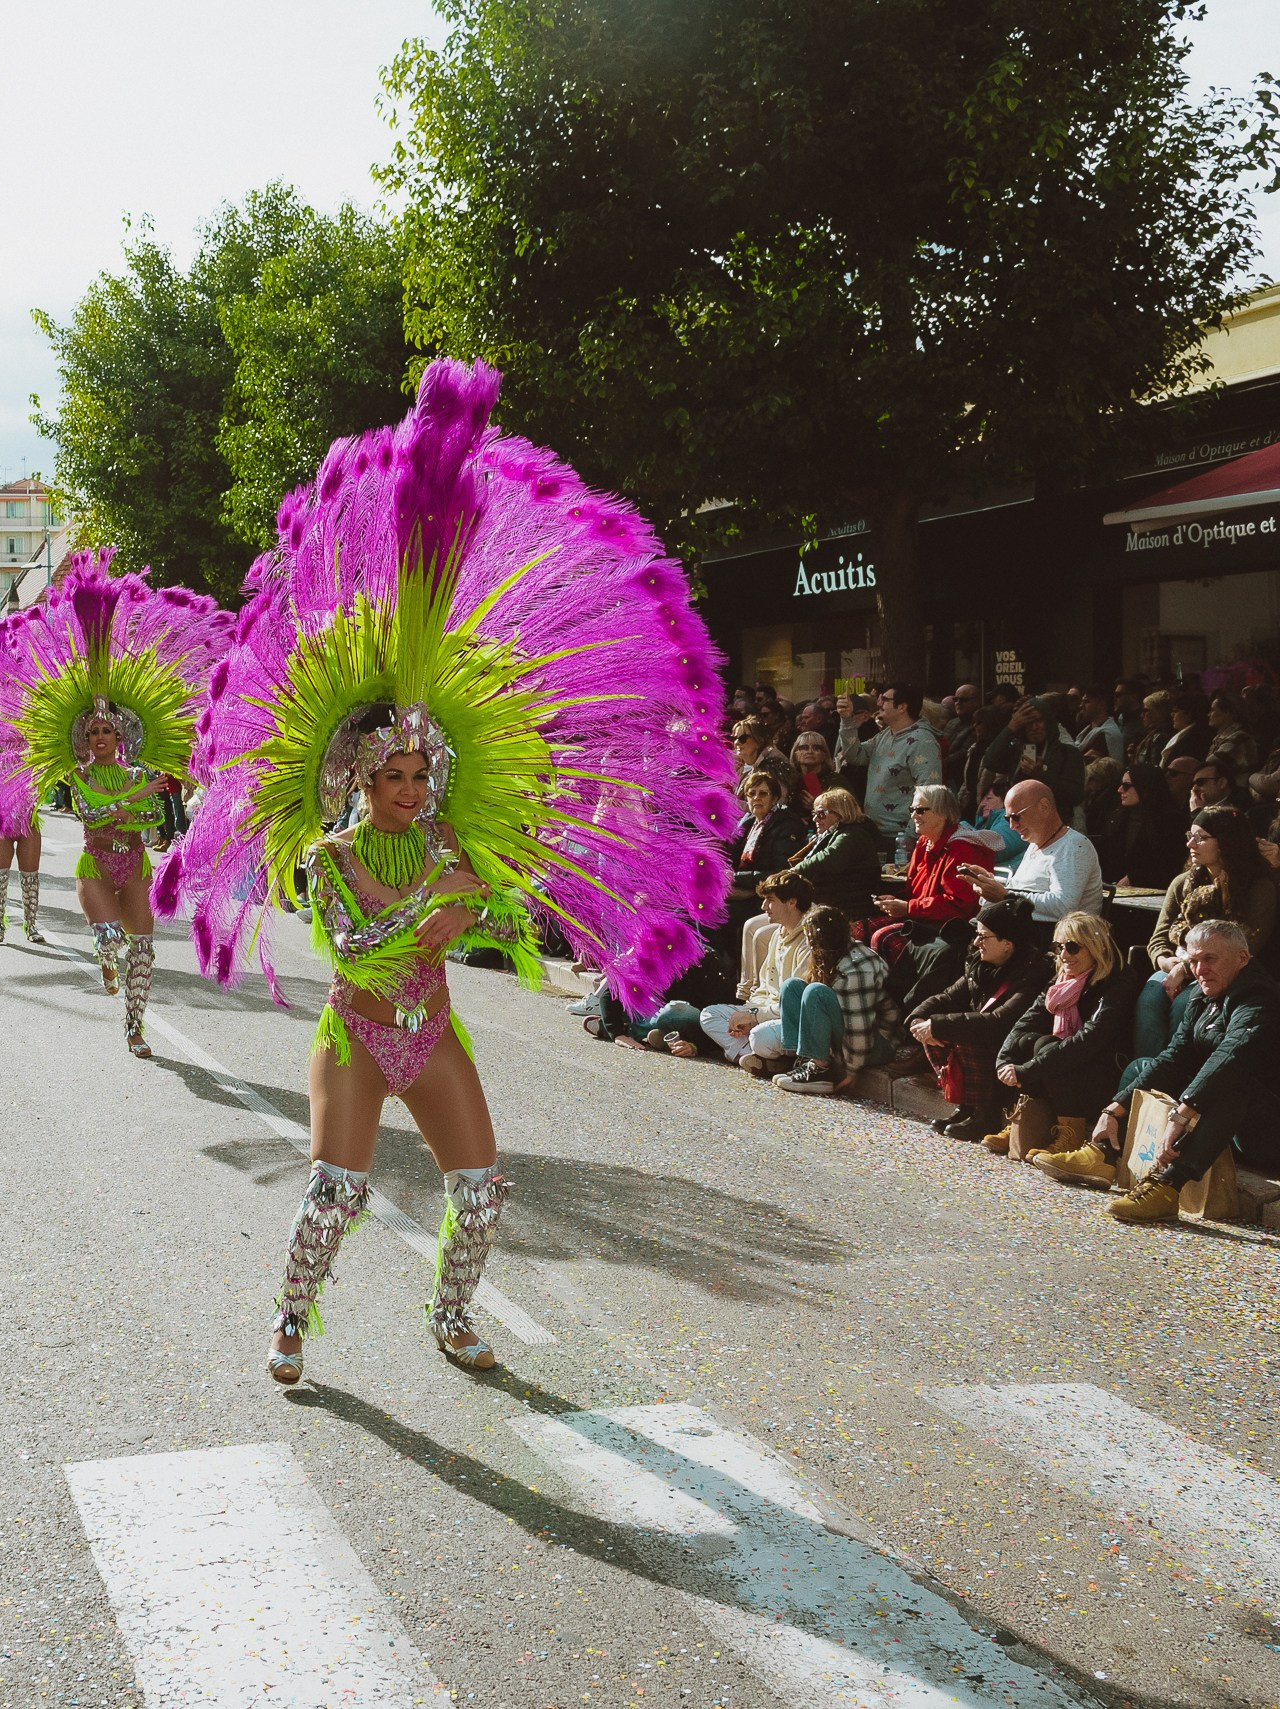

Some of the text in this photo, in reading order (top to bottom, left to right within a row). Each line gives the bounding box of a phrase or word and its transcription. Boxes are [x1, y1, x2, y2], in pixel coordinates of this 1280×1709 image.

[1154, 452, 1186, 467] Maison
[1188, 442, 1247, 460] d'Optique
[1249, 437, 1260, 448] et
[1125, 516, 1277, 552] Maison d'Optique et
[792, 552, 877, 597] Acuitis
[995, 650, 1016, 662] VOS
[995, 673, 1023, 685] VOUS
